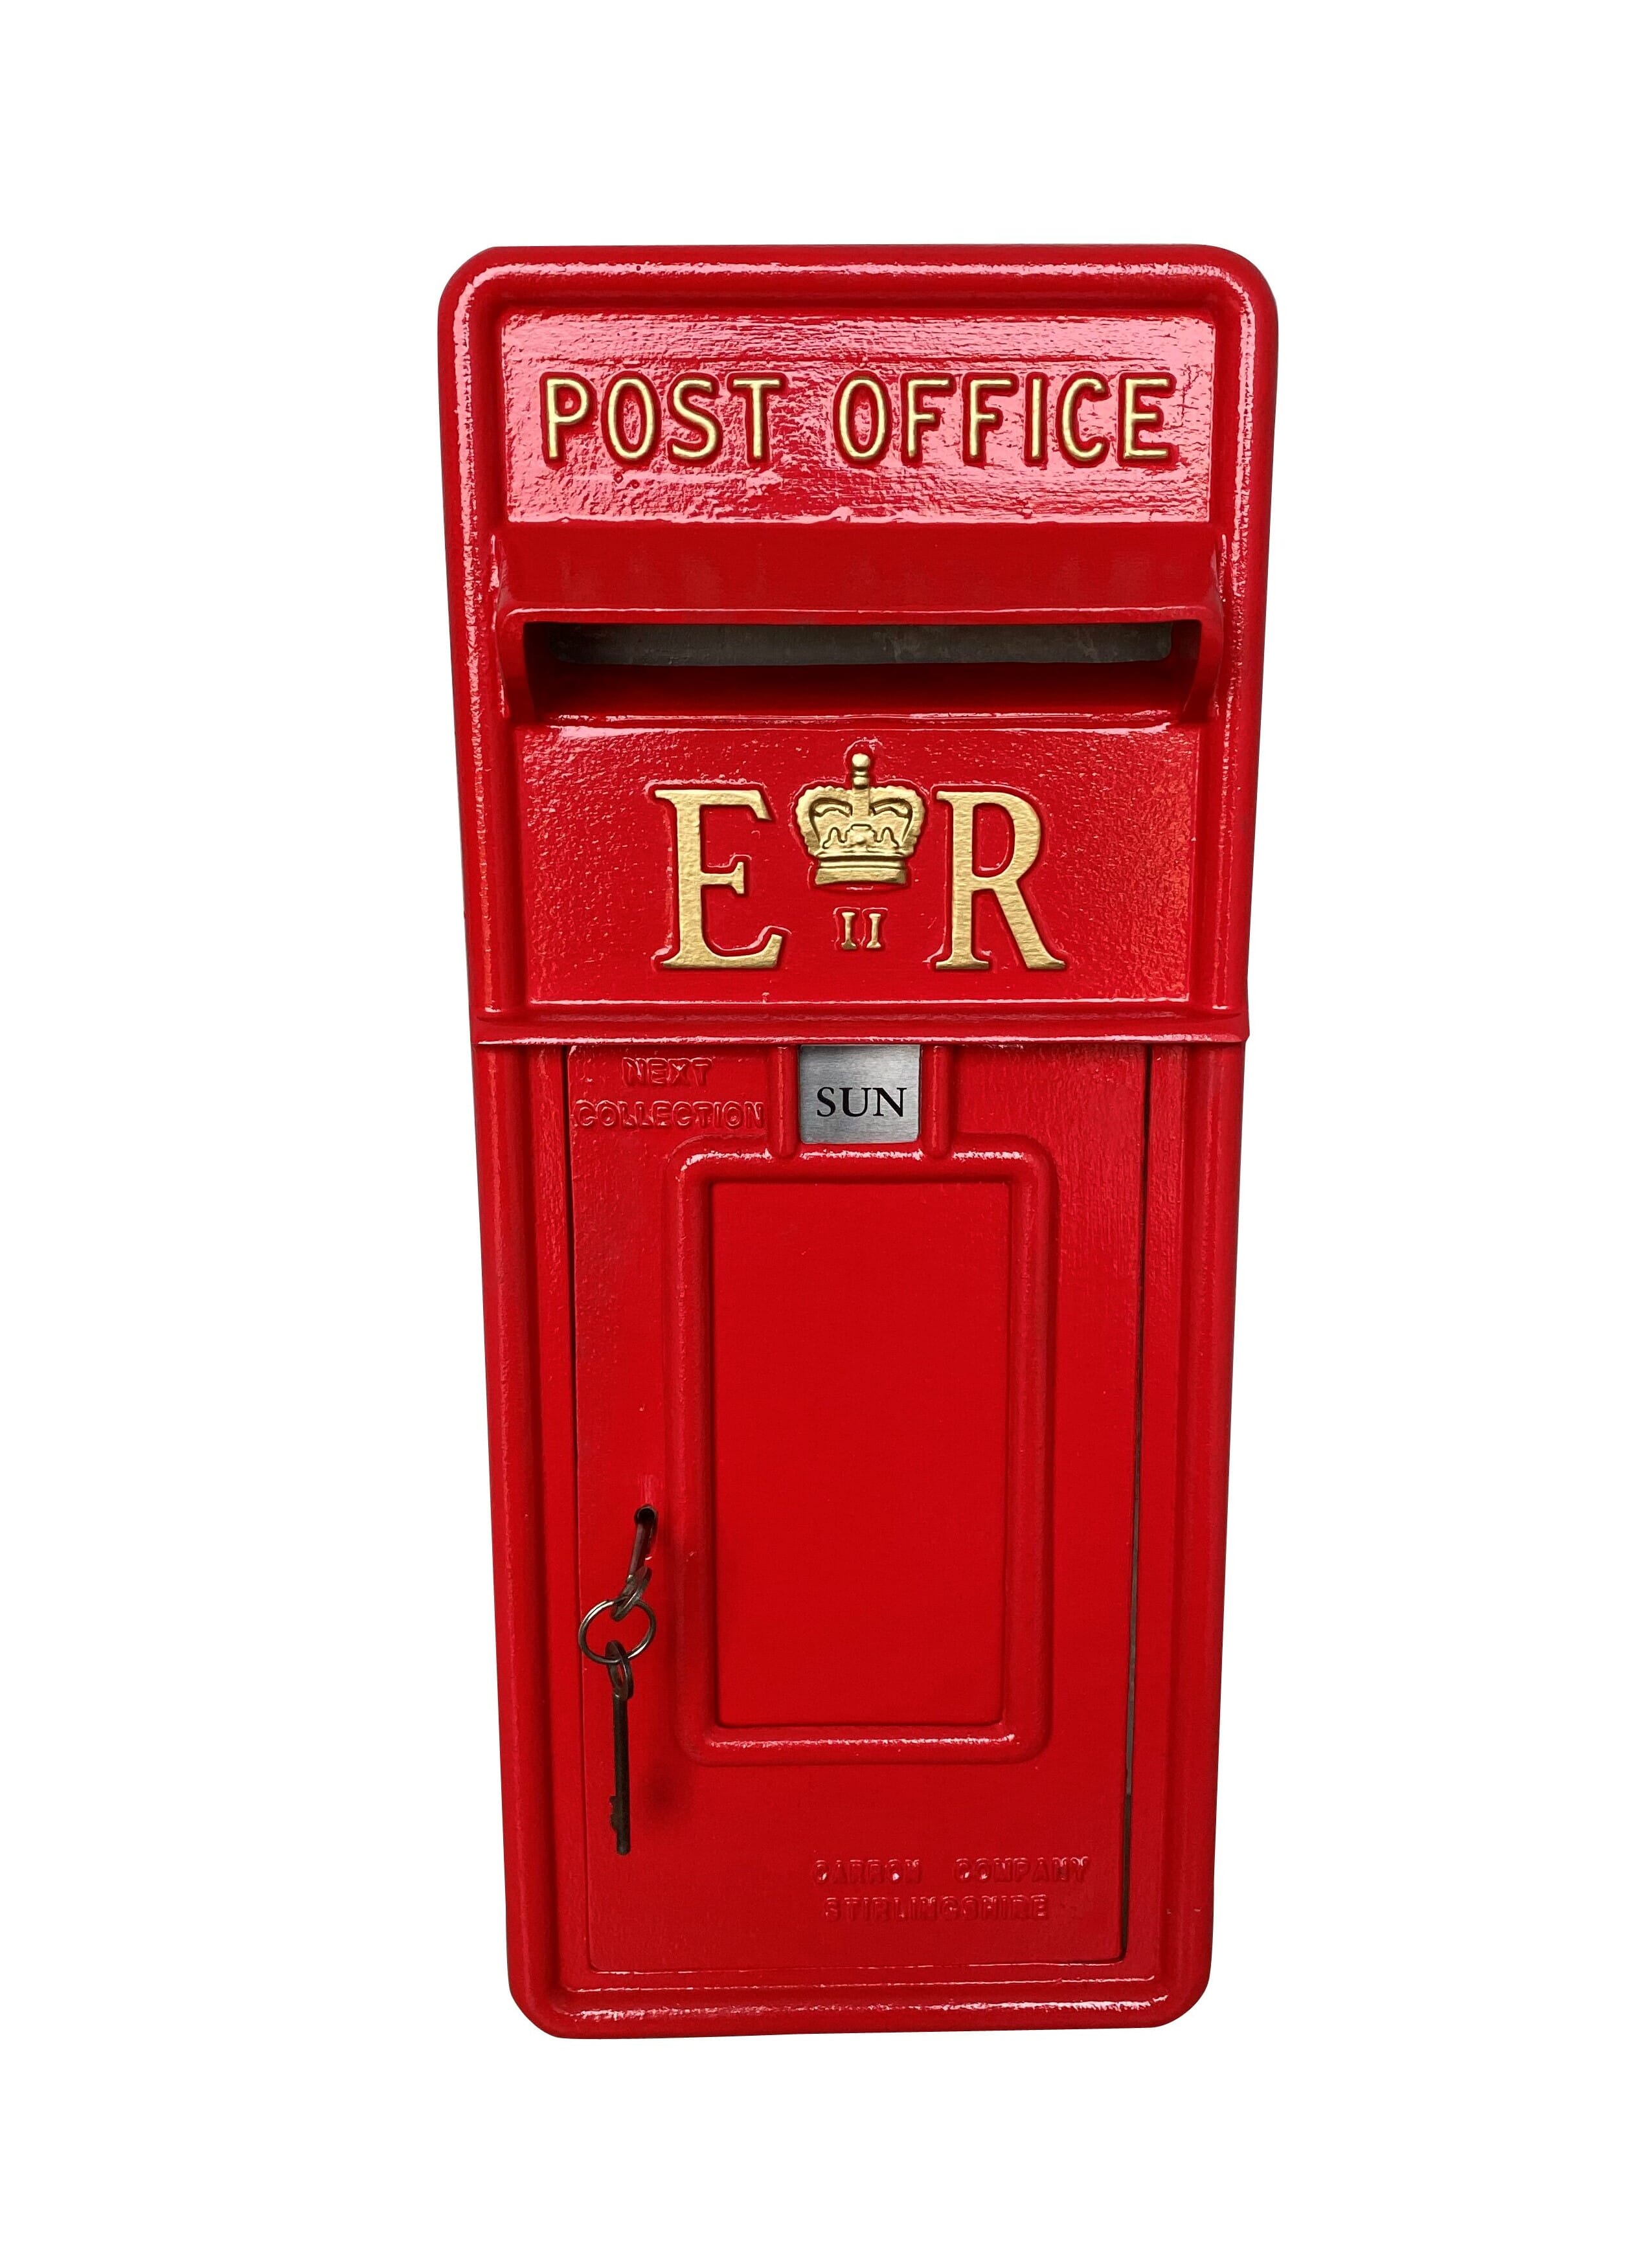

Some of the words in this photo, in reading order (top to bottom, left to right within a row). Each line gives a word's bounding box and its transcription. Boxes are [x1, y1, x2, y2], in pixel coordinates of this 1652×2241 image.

[546, 377, 786, 460] POST
[839, 377, 1171, 462] OFFICE
[654, 789, 784, 969] E
[936, 791, 1067, 969] R
[841, 912, 881, 950] II
[622, 1057, 712, 1087] NEXT
[573, 1099, 765, 1129] COLLECTION
[816, 1087, 907, 1118] SUN
[813, 1859, 922, 1884] CARRON
[955, 1856, 1091, 1882] COMPANY
[824, 1894, 1049, 1922] STIRLINGSHIRE
